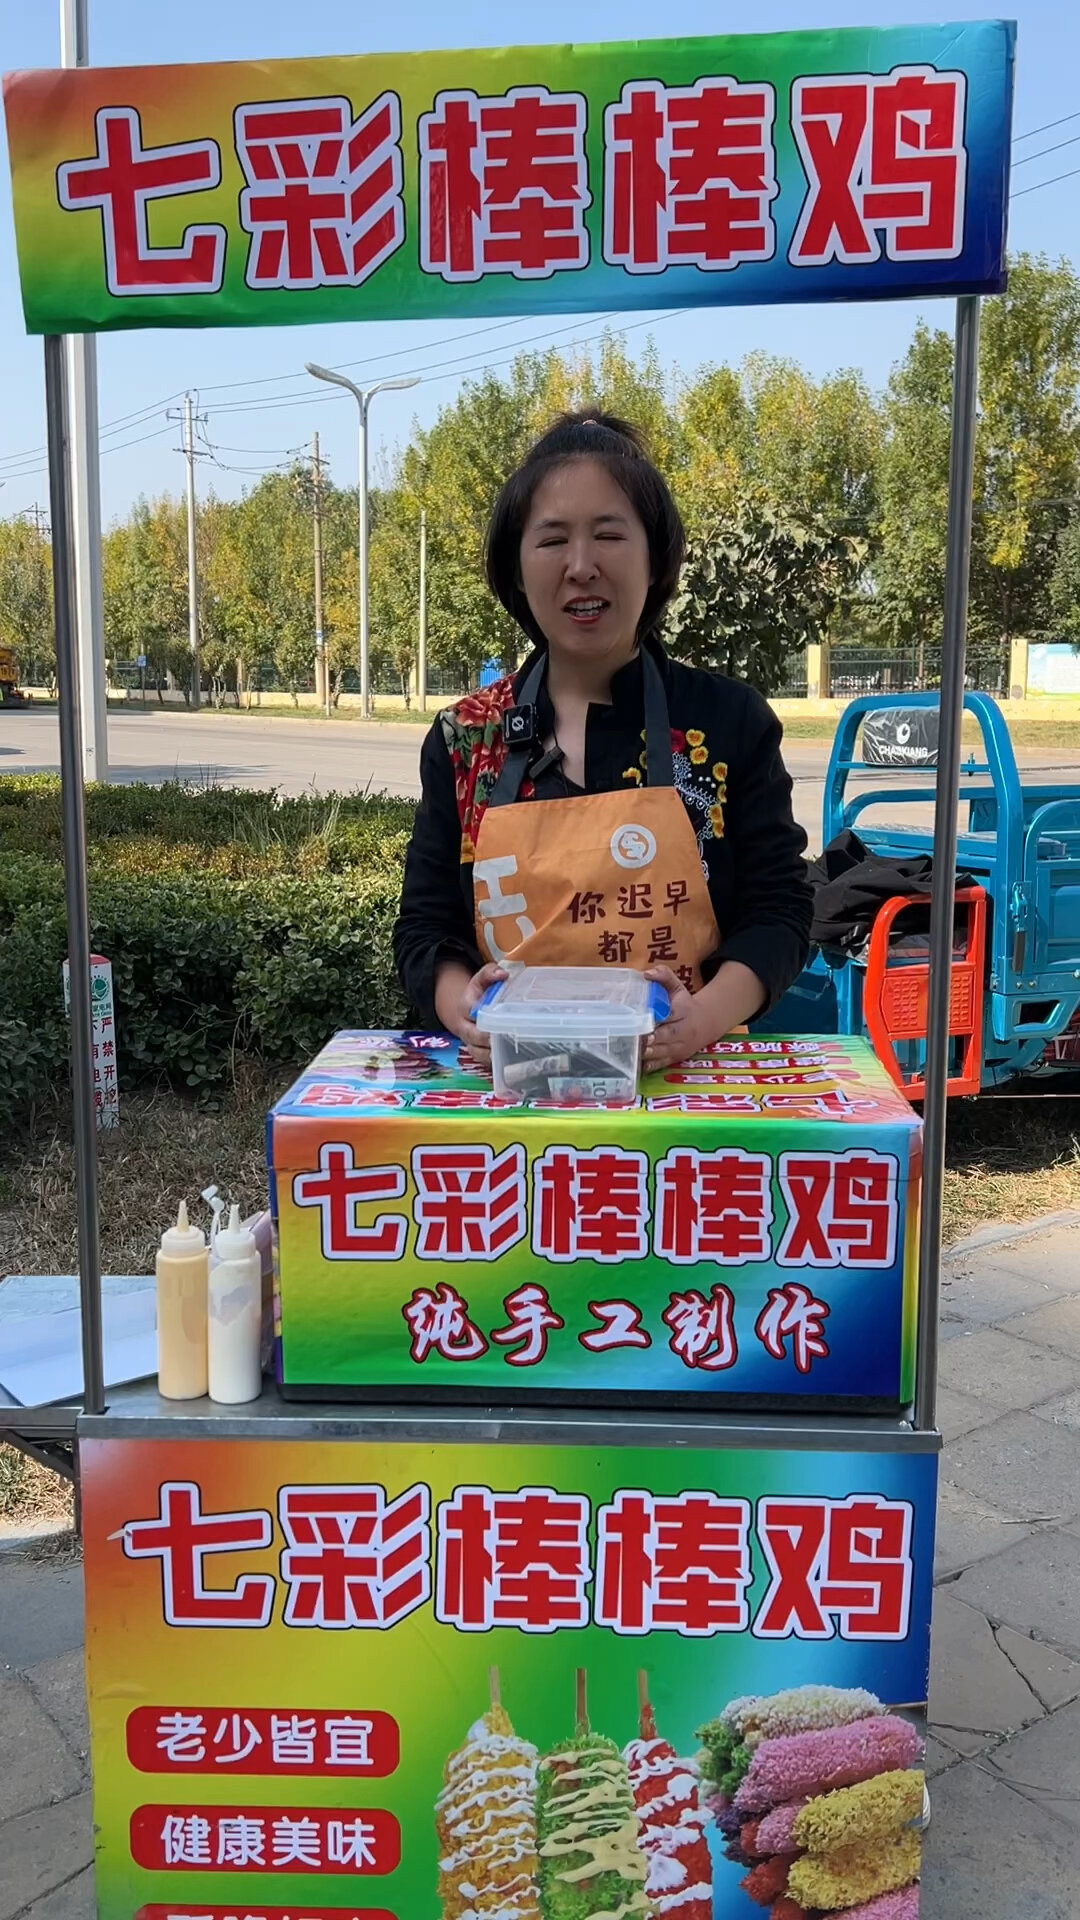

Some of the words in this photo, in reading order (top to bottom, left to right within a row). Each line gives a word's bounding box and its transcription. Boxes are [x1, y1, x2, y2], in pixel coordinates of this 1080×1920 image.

[57, 65, 967, 297] 七彩棒棒鸡
[567, 880, 691, 924] 你迟早
[598, 925, 679, 963] 都是
[701, 1041, 820, 1053] 酥脆好
[592, 1080, 607, 1098] 10
[293, 1142, 899, 1268] 七彩棒棒鸡
[402, 1281, 829, 1372] 纯手工制作
[123, 1481, 914, 1641] 七彩棒棒鸡
[156, 1713, 374, 1767] 老少皆宜
[160, 1816, 376, 1868] 健康美味
